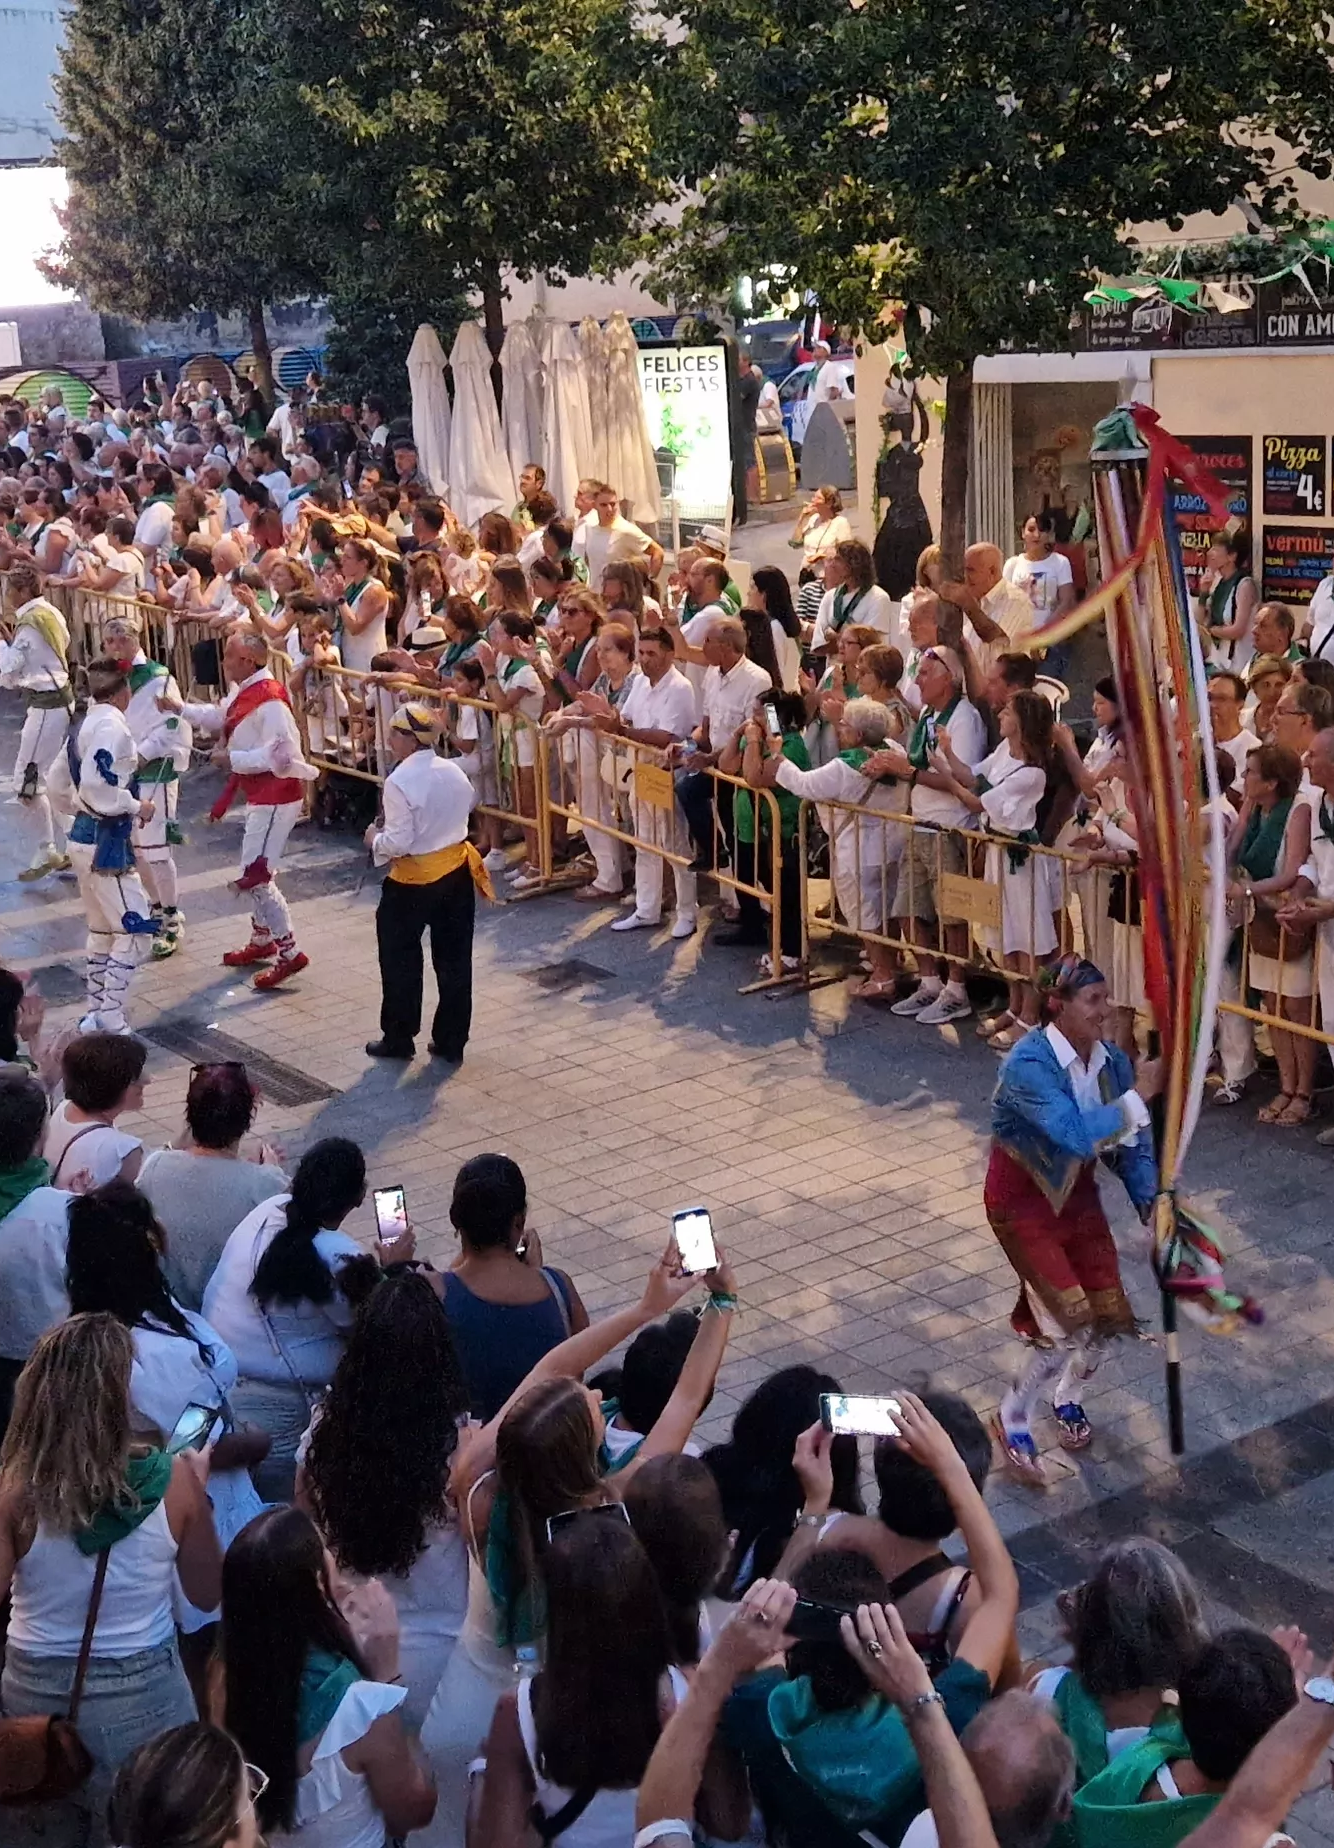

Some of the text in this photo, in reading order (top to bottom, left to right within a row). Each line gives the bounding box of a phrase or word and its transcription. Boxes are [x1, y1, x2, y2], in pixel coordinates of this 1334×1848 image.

[1267, 314, 1300, 337] CON
[643, 355, 719, 373] FELICES
[644, 376, 720, 393] FIESTAS
[1265, 437, 1322, 469] Pizza
[1267, 530, 1324, 553] vermú
